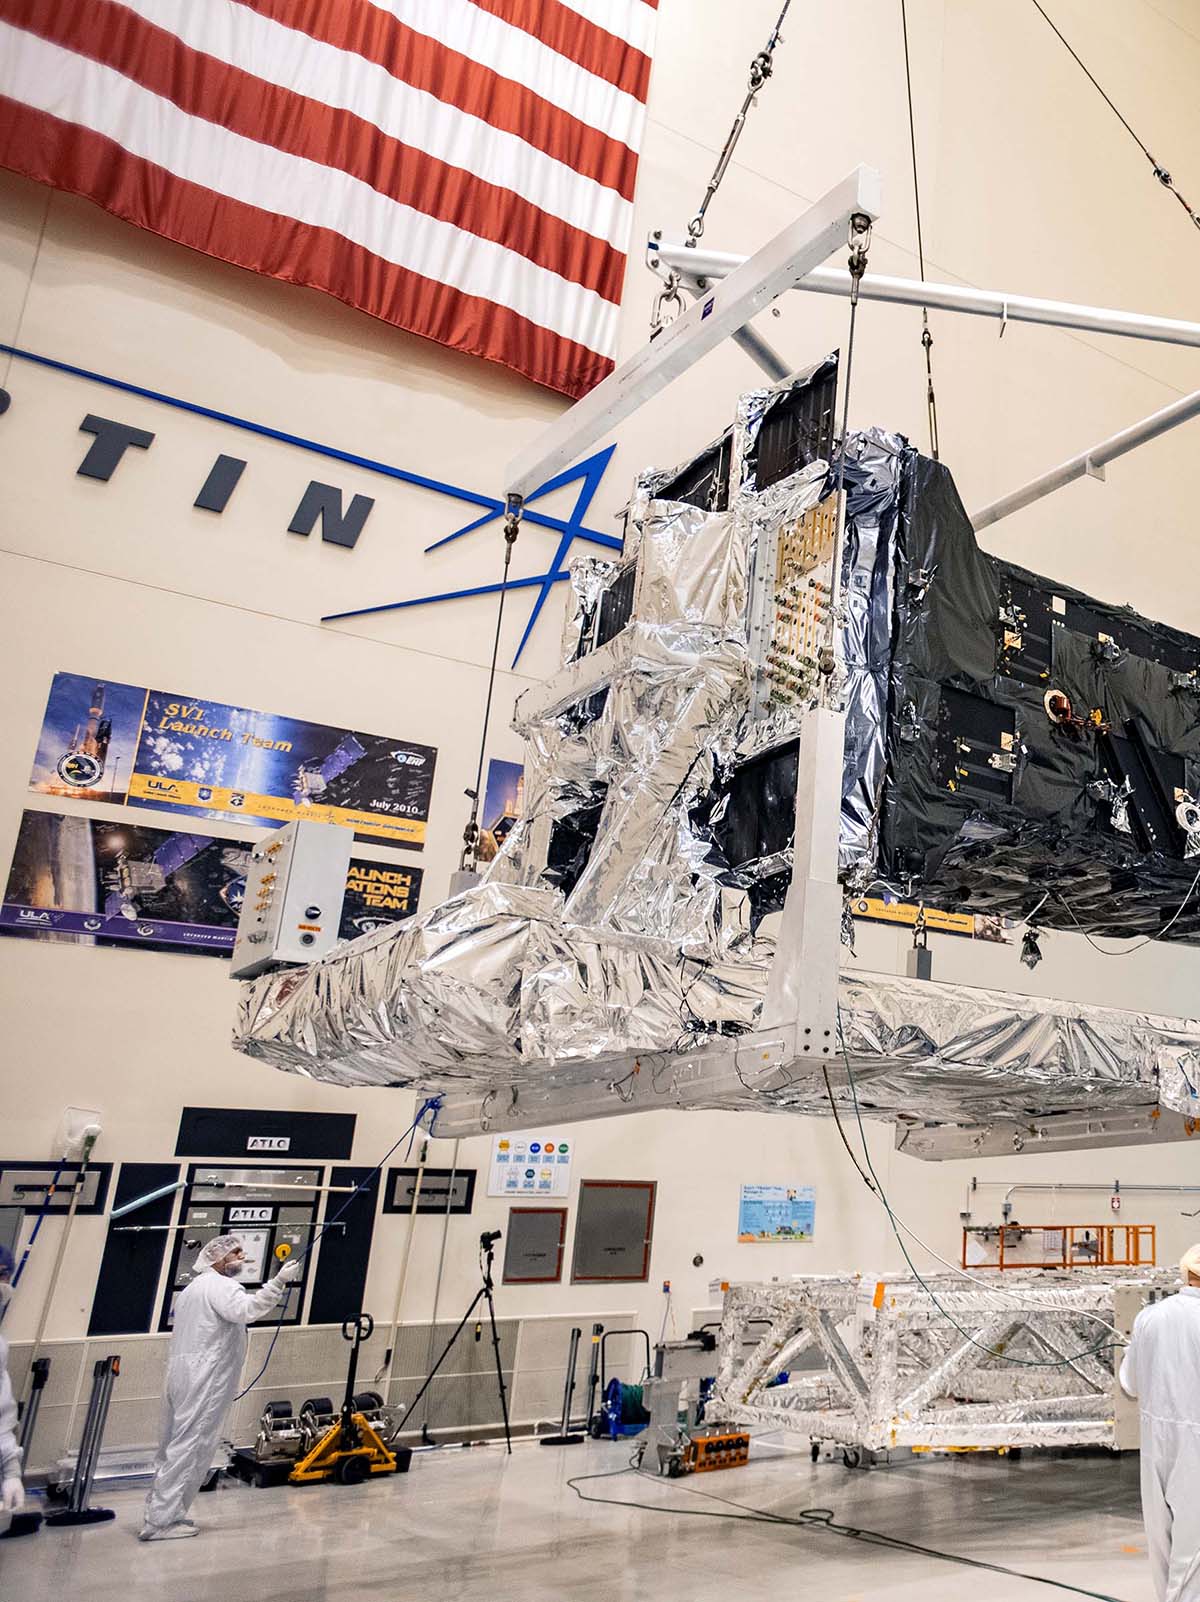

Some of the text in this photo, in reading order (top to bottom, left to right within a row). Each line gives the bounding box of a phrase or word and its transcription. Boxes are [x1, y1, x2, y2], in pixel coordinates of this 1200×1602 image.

[0, 387, 376, 550] TIN
[158, 716, 294, 752] Launch Team
[369, 799, 419, 815] July 2010
[362, 893, 409, 911] TEAM
